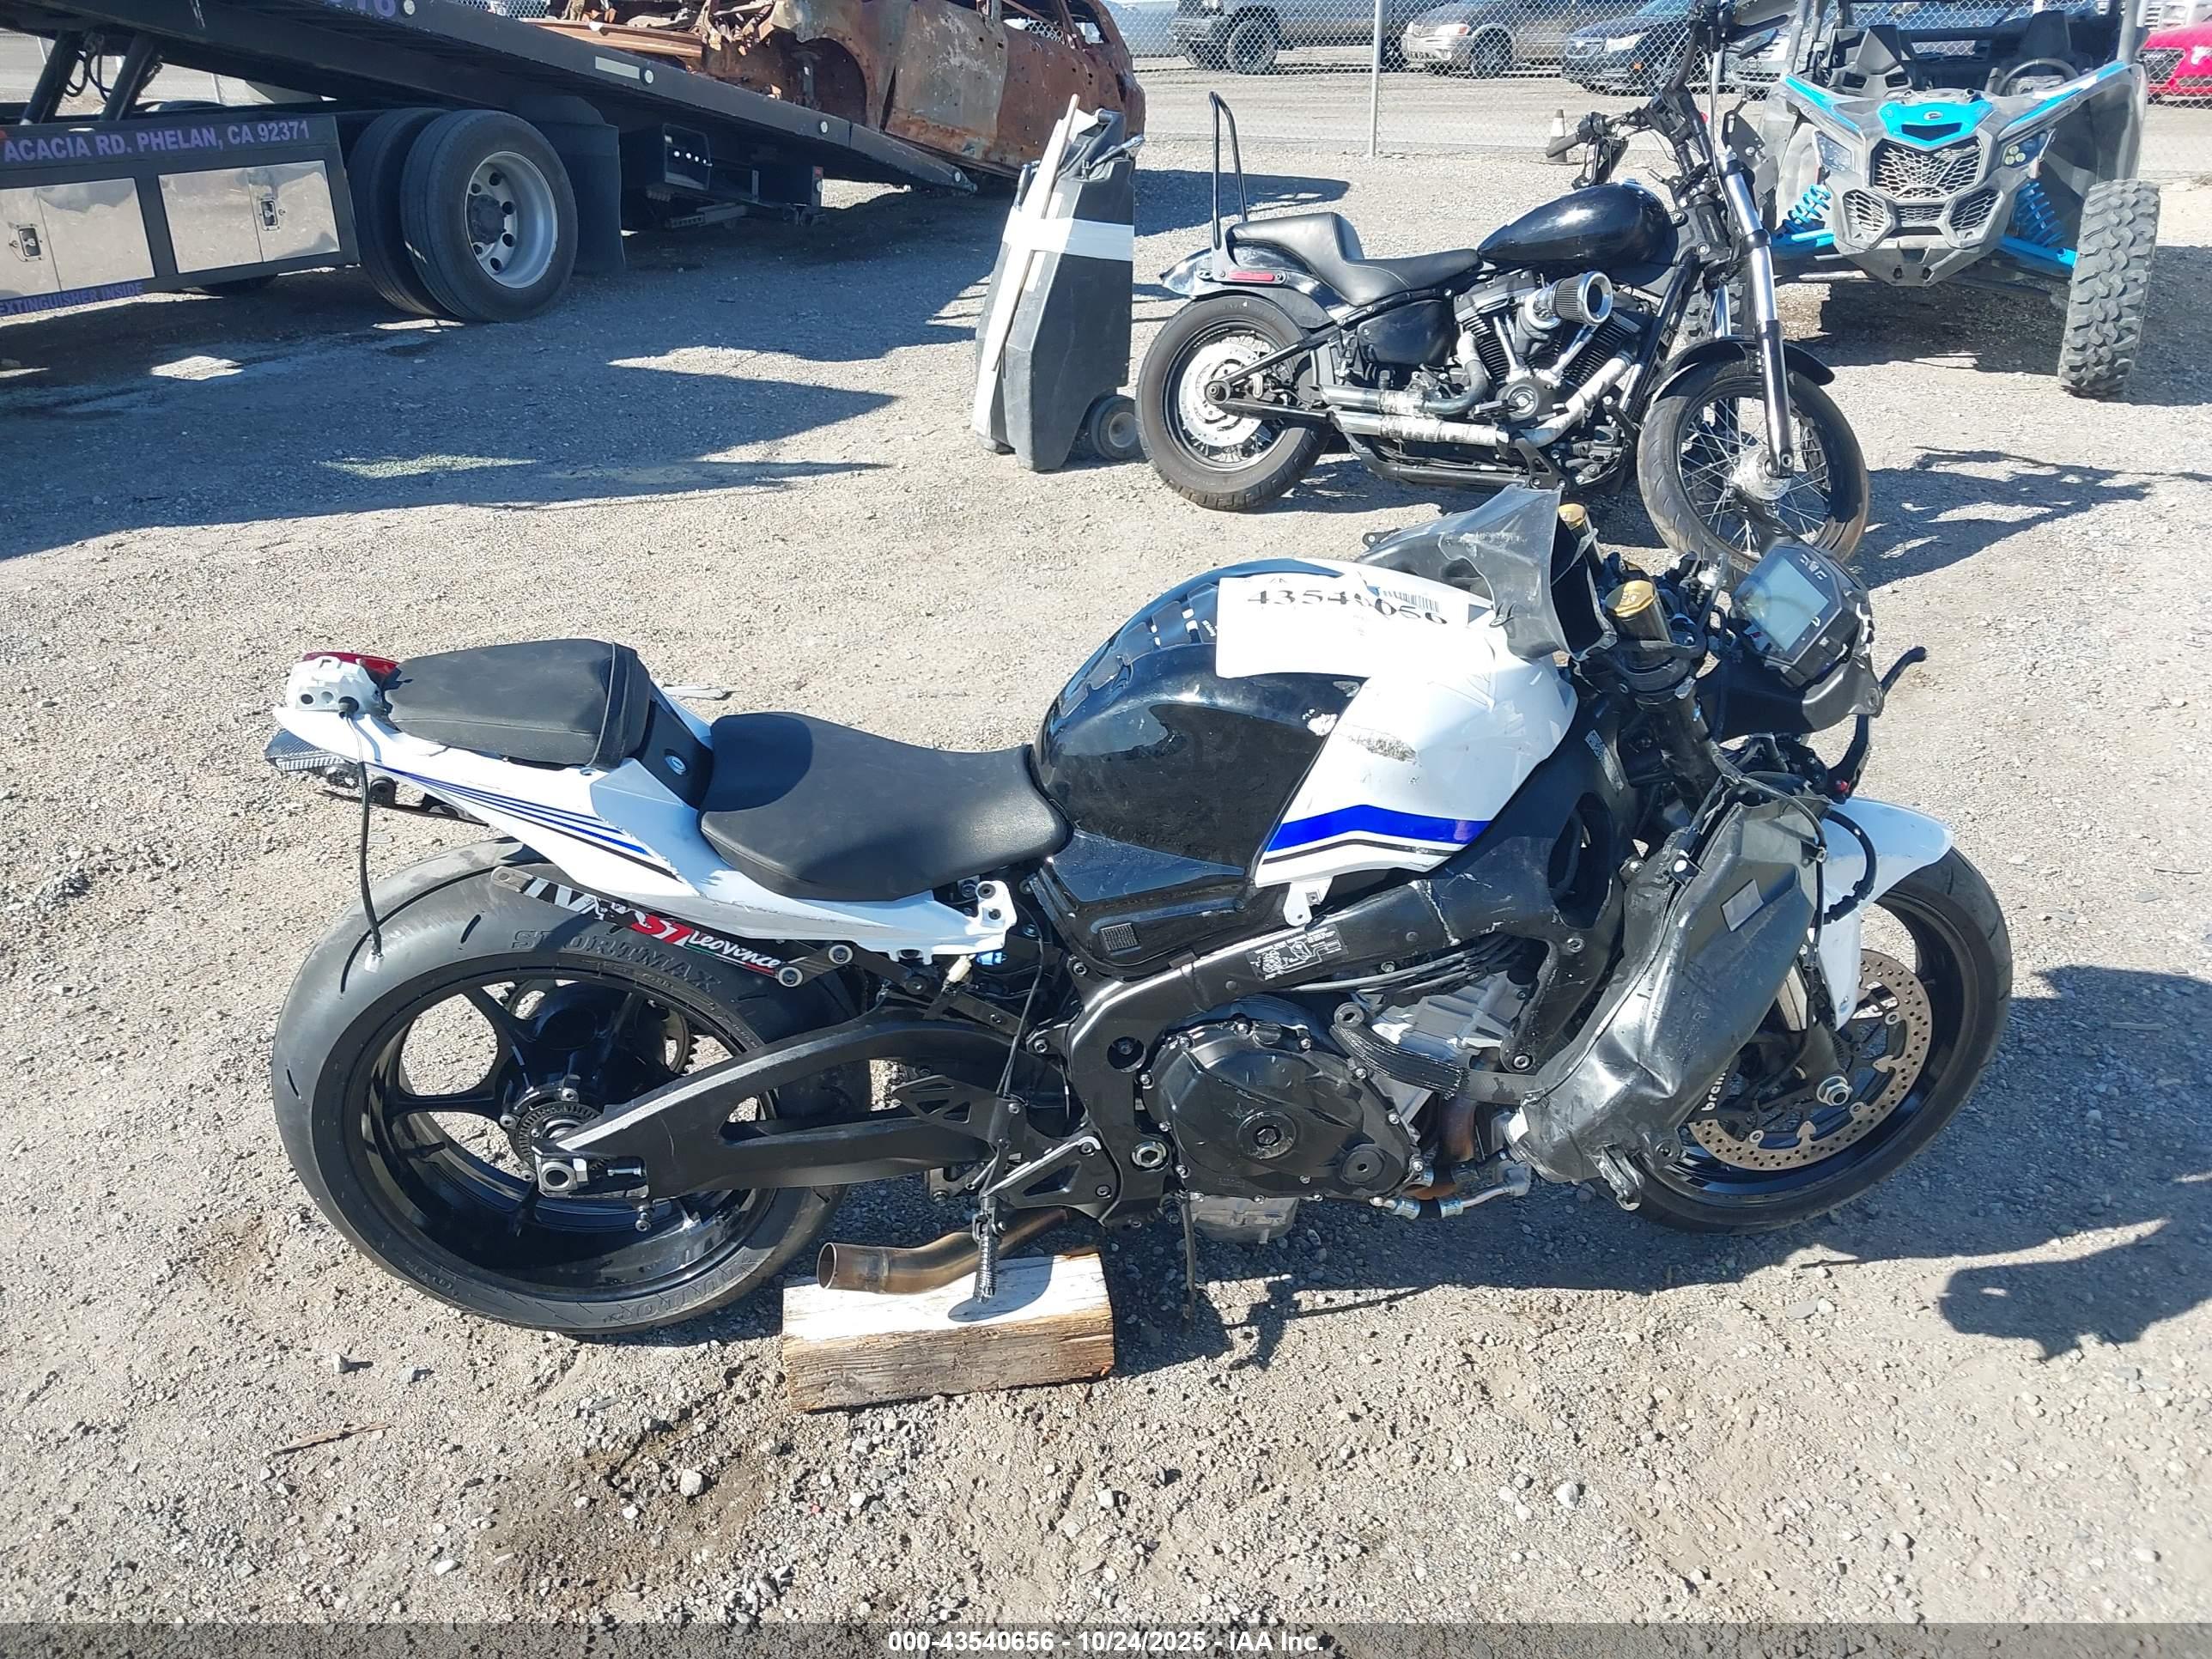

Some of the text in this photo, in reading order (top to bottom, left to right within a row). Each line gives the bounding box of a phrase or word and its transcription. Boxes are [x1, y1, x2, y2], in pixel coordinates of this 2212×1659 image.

[4, 120, 310, 162] ACACIA RD. PHELAN, CA 92371
[102, 282, 143, 302] INSIDE
[1701, 1066, 1729, 1112] brem
